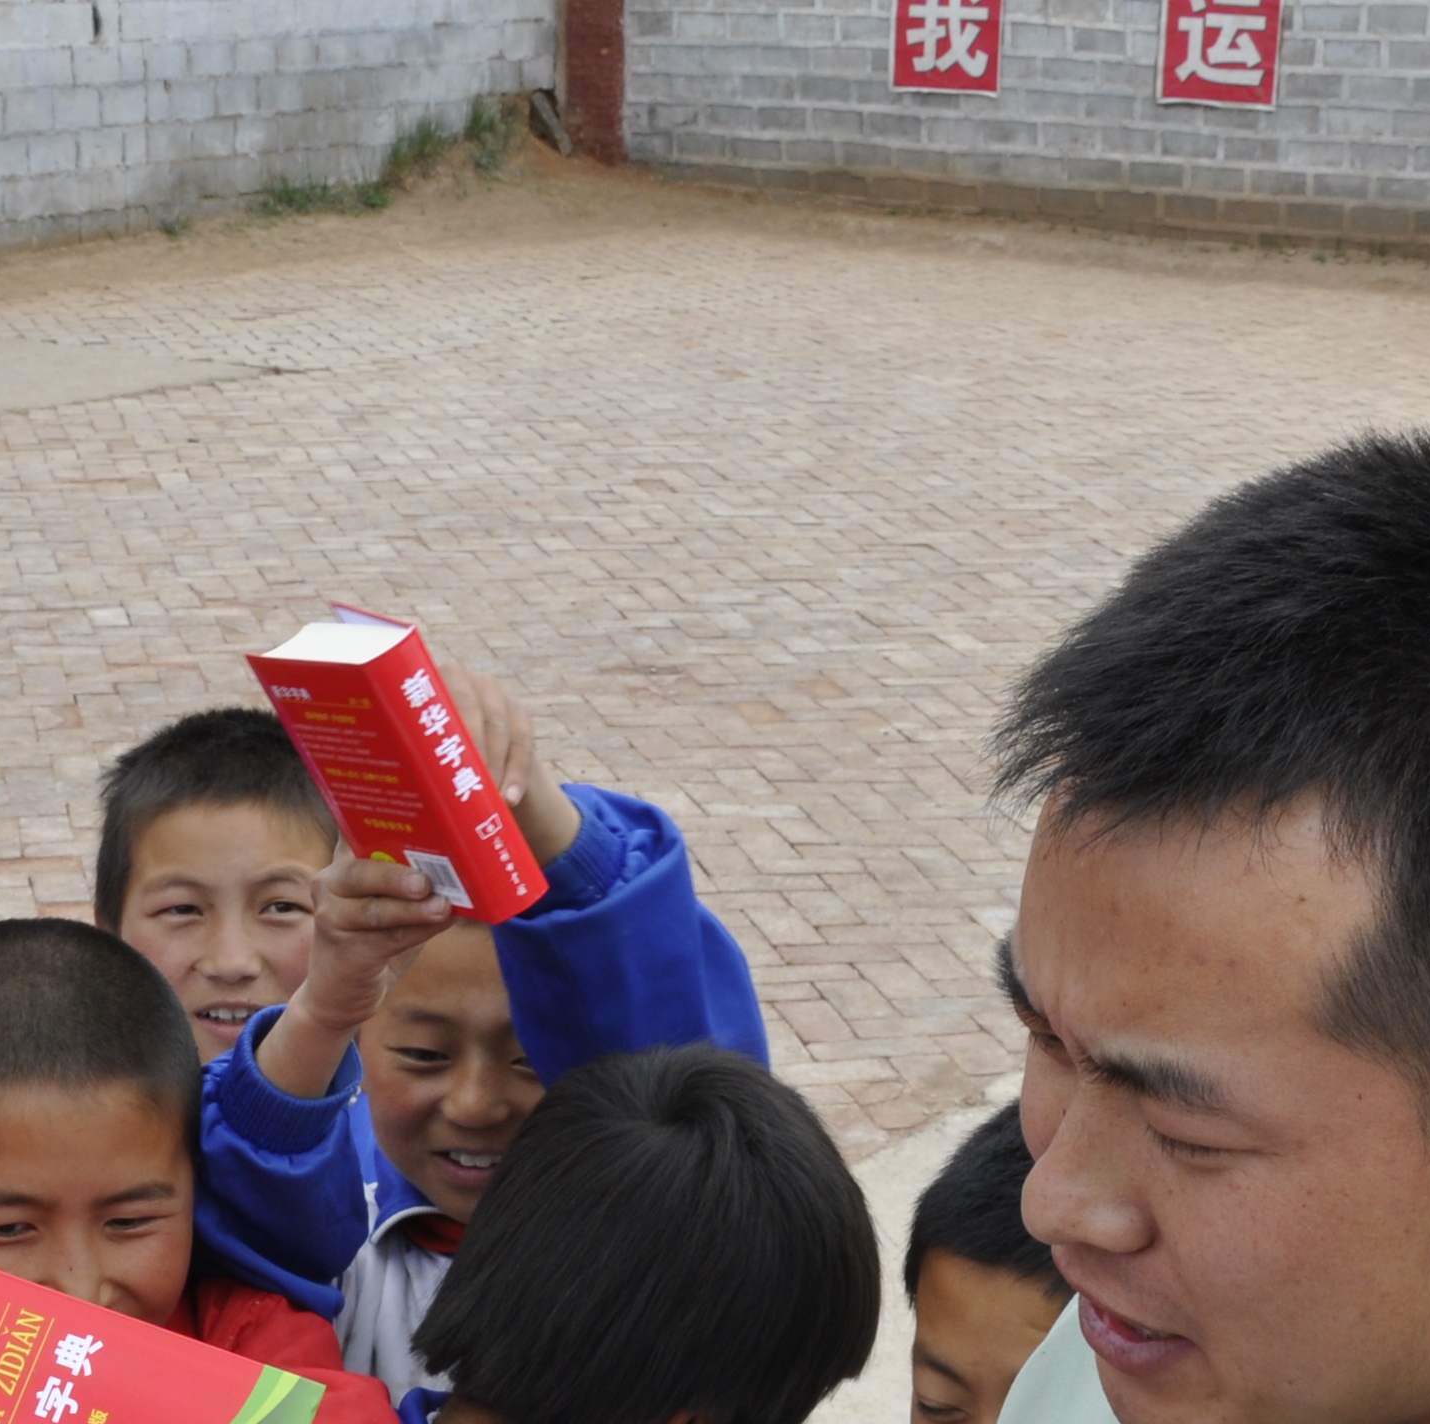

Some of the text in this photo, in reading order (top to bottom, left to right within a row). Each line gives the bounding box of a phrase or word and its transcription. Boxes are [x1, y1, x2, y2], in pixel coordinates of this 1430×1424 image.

[905, 0, 989, 78] 我
[1175, 0, 1265, 87] 运
[400, 668, 483, 802] 新华字典
